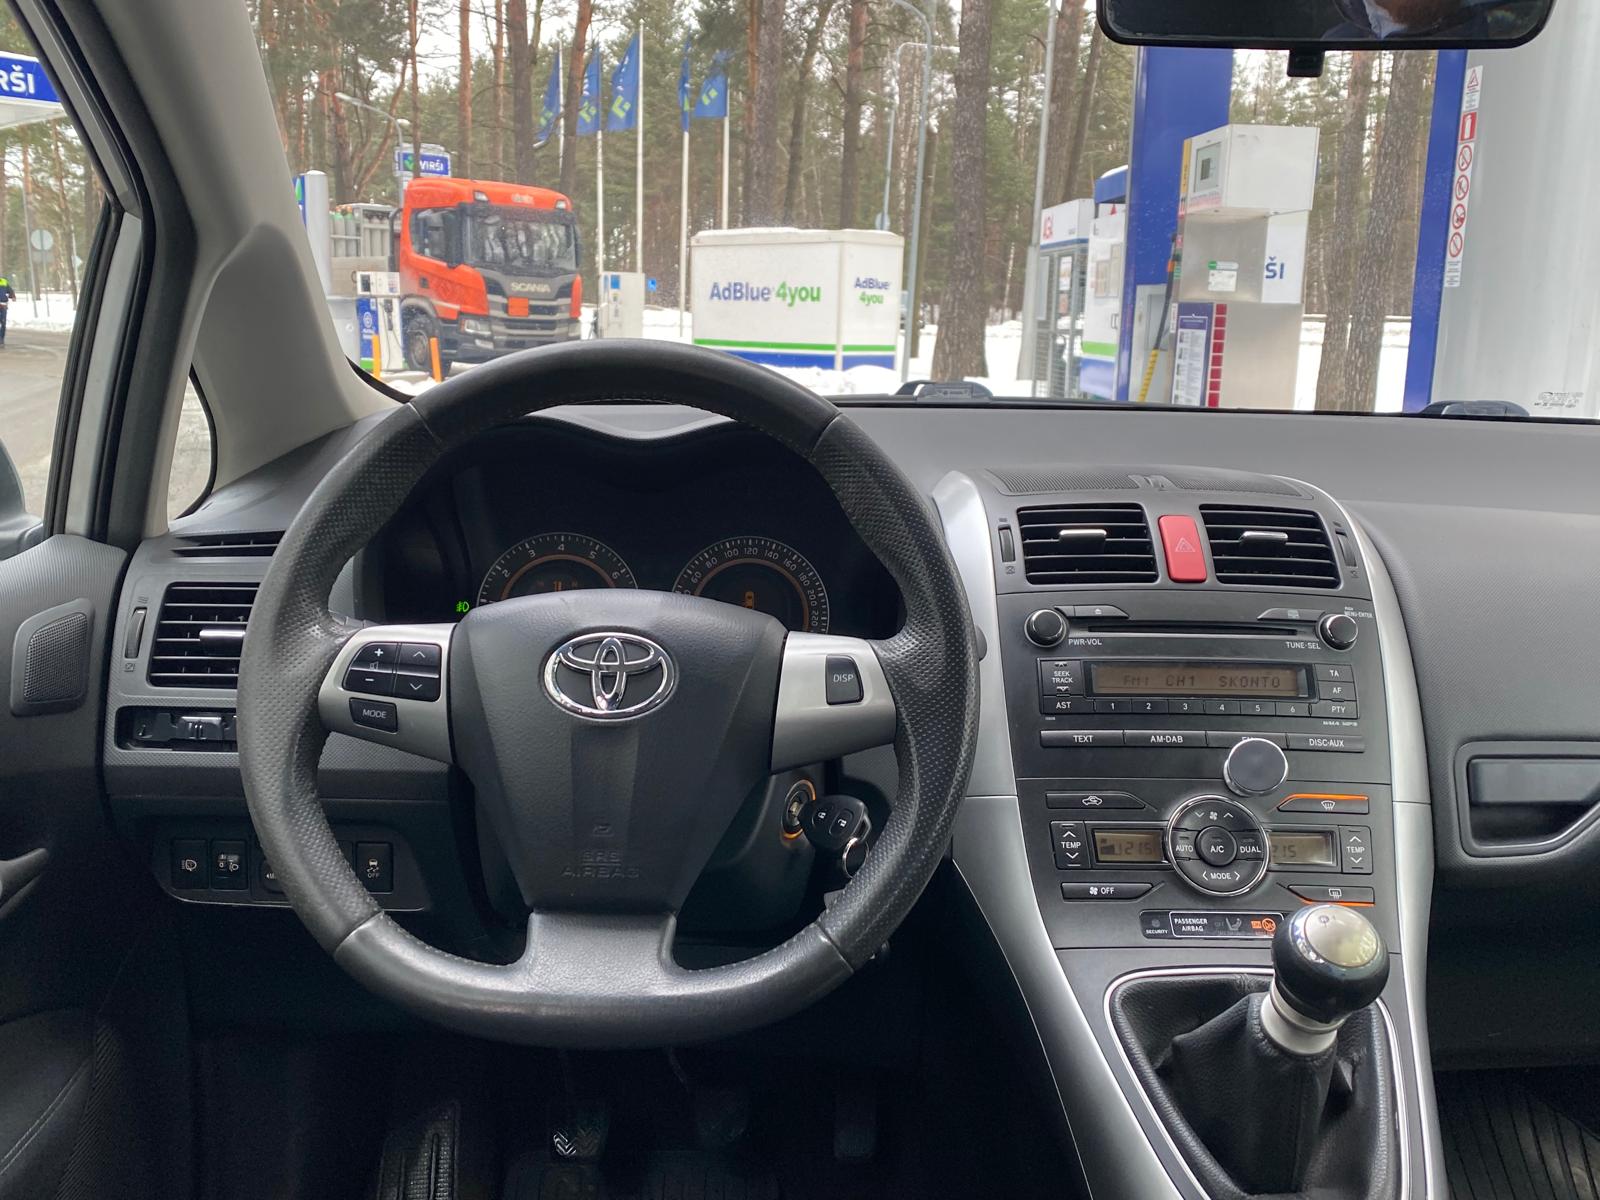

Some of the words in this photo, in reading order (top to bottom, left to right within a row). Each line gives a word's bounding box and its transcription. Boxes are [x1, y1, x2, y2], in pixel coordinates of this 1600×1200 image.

[511, 282, 550, 293] SCANIA
[775, 281, 822, 307] 4you
[859, 291, 884, 306] 4you
[557, 543, 565, 551] 4
[744, 547, 758, 555] 120
[529, 550, 536, 558] 3
[589, 551, 597, 560] 5
[724, 548, 739, 558] 100
[764, 549, 779, 560] 140
[705, 557, 718, 568] 80
[784, 558, 797, 571] 160
[502, 570, 511, 578] 2
[612, 571, 620, 579] 6
[691, 571, 702, 583] 60
[799, 572, 811, 586] 180
[807, 589, 818, 607] 200
[811, 611, 819, 627] 220
[833, 673, 854, 682] DISP
[1165, 675, 1195, 687] CH1
[1218, 675, 1280, 688] SKONTO
[1055, 701, 1072, 709] AST
[1111, 702, 1115, 710] 1
[362, 709, 387, 718] MODE
[1073, 735, 1094, 743] TEXT
[1060, 841, 1081, 849] TEMP
[1210, 845, 1225, 853] A/C
[1240, 845, 1262, 853] DUAL
[1346, 846, 1366, 854] TEMP
[1210, 872, 1232, 880] MODE
